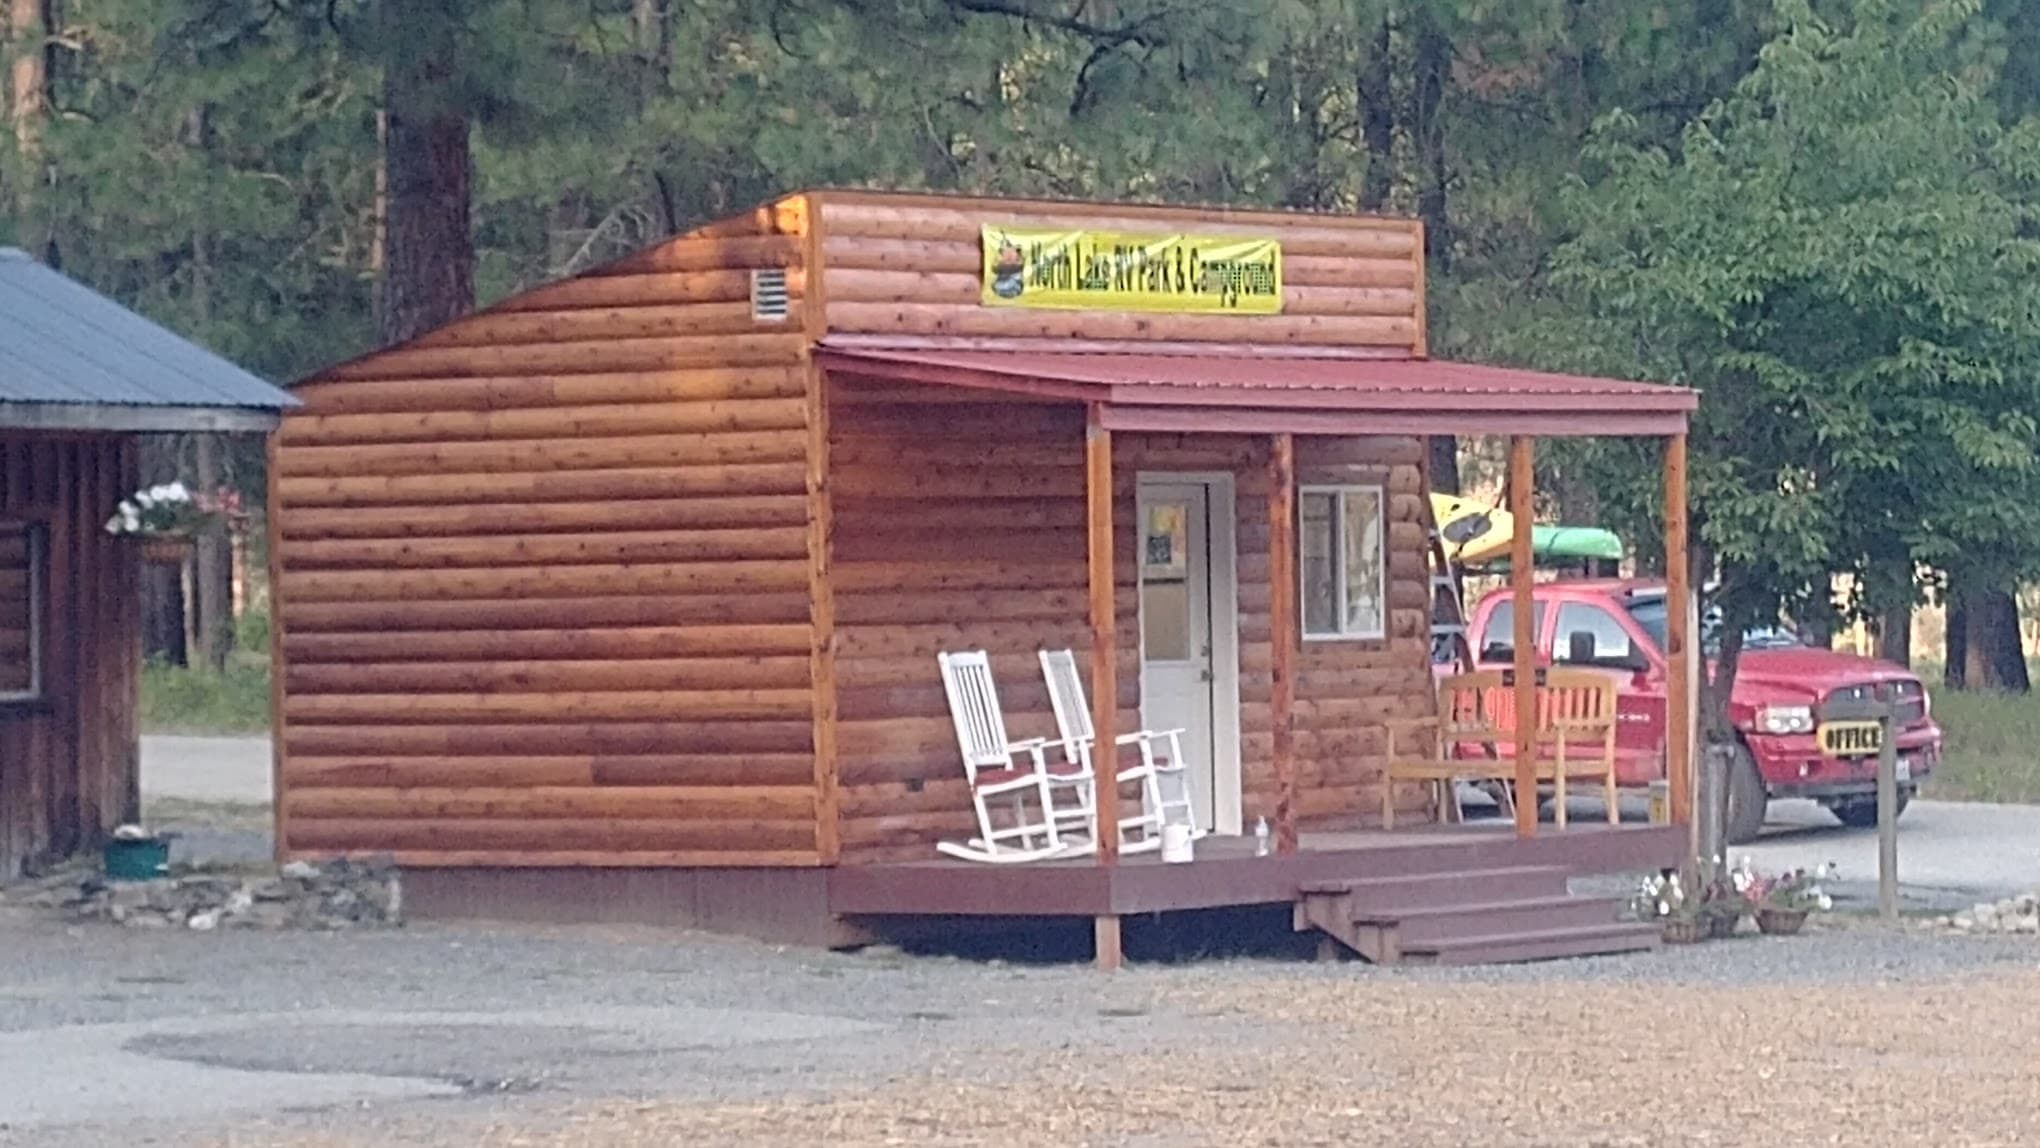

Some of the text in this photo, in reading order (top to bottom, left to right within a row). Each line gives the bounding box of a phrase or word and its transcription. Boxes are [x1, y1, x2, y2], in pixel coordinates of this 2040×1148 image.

[1030, 242, 1277, 307] North Lake RV Park & Campground
[1825, 727, 1880, 749] OFFICE
